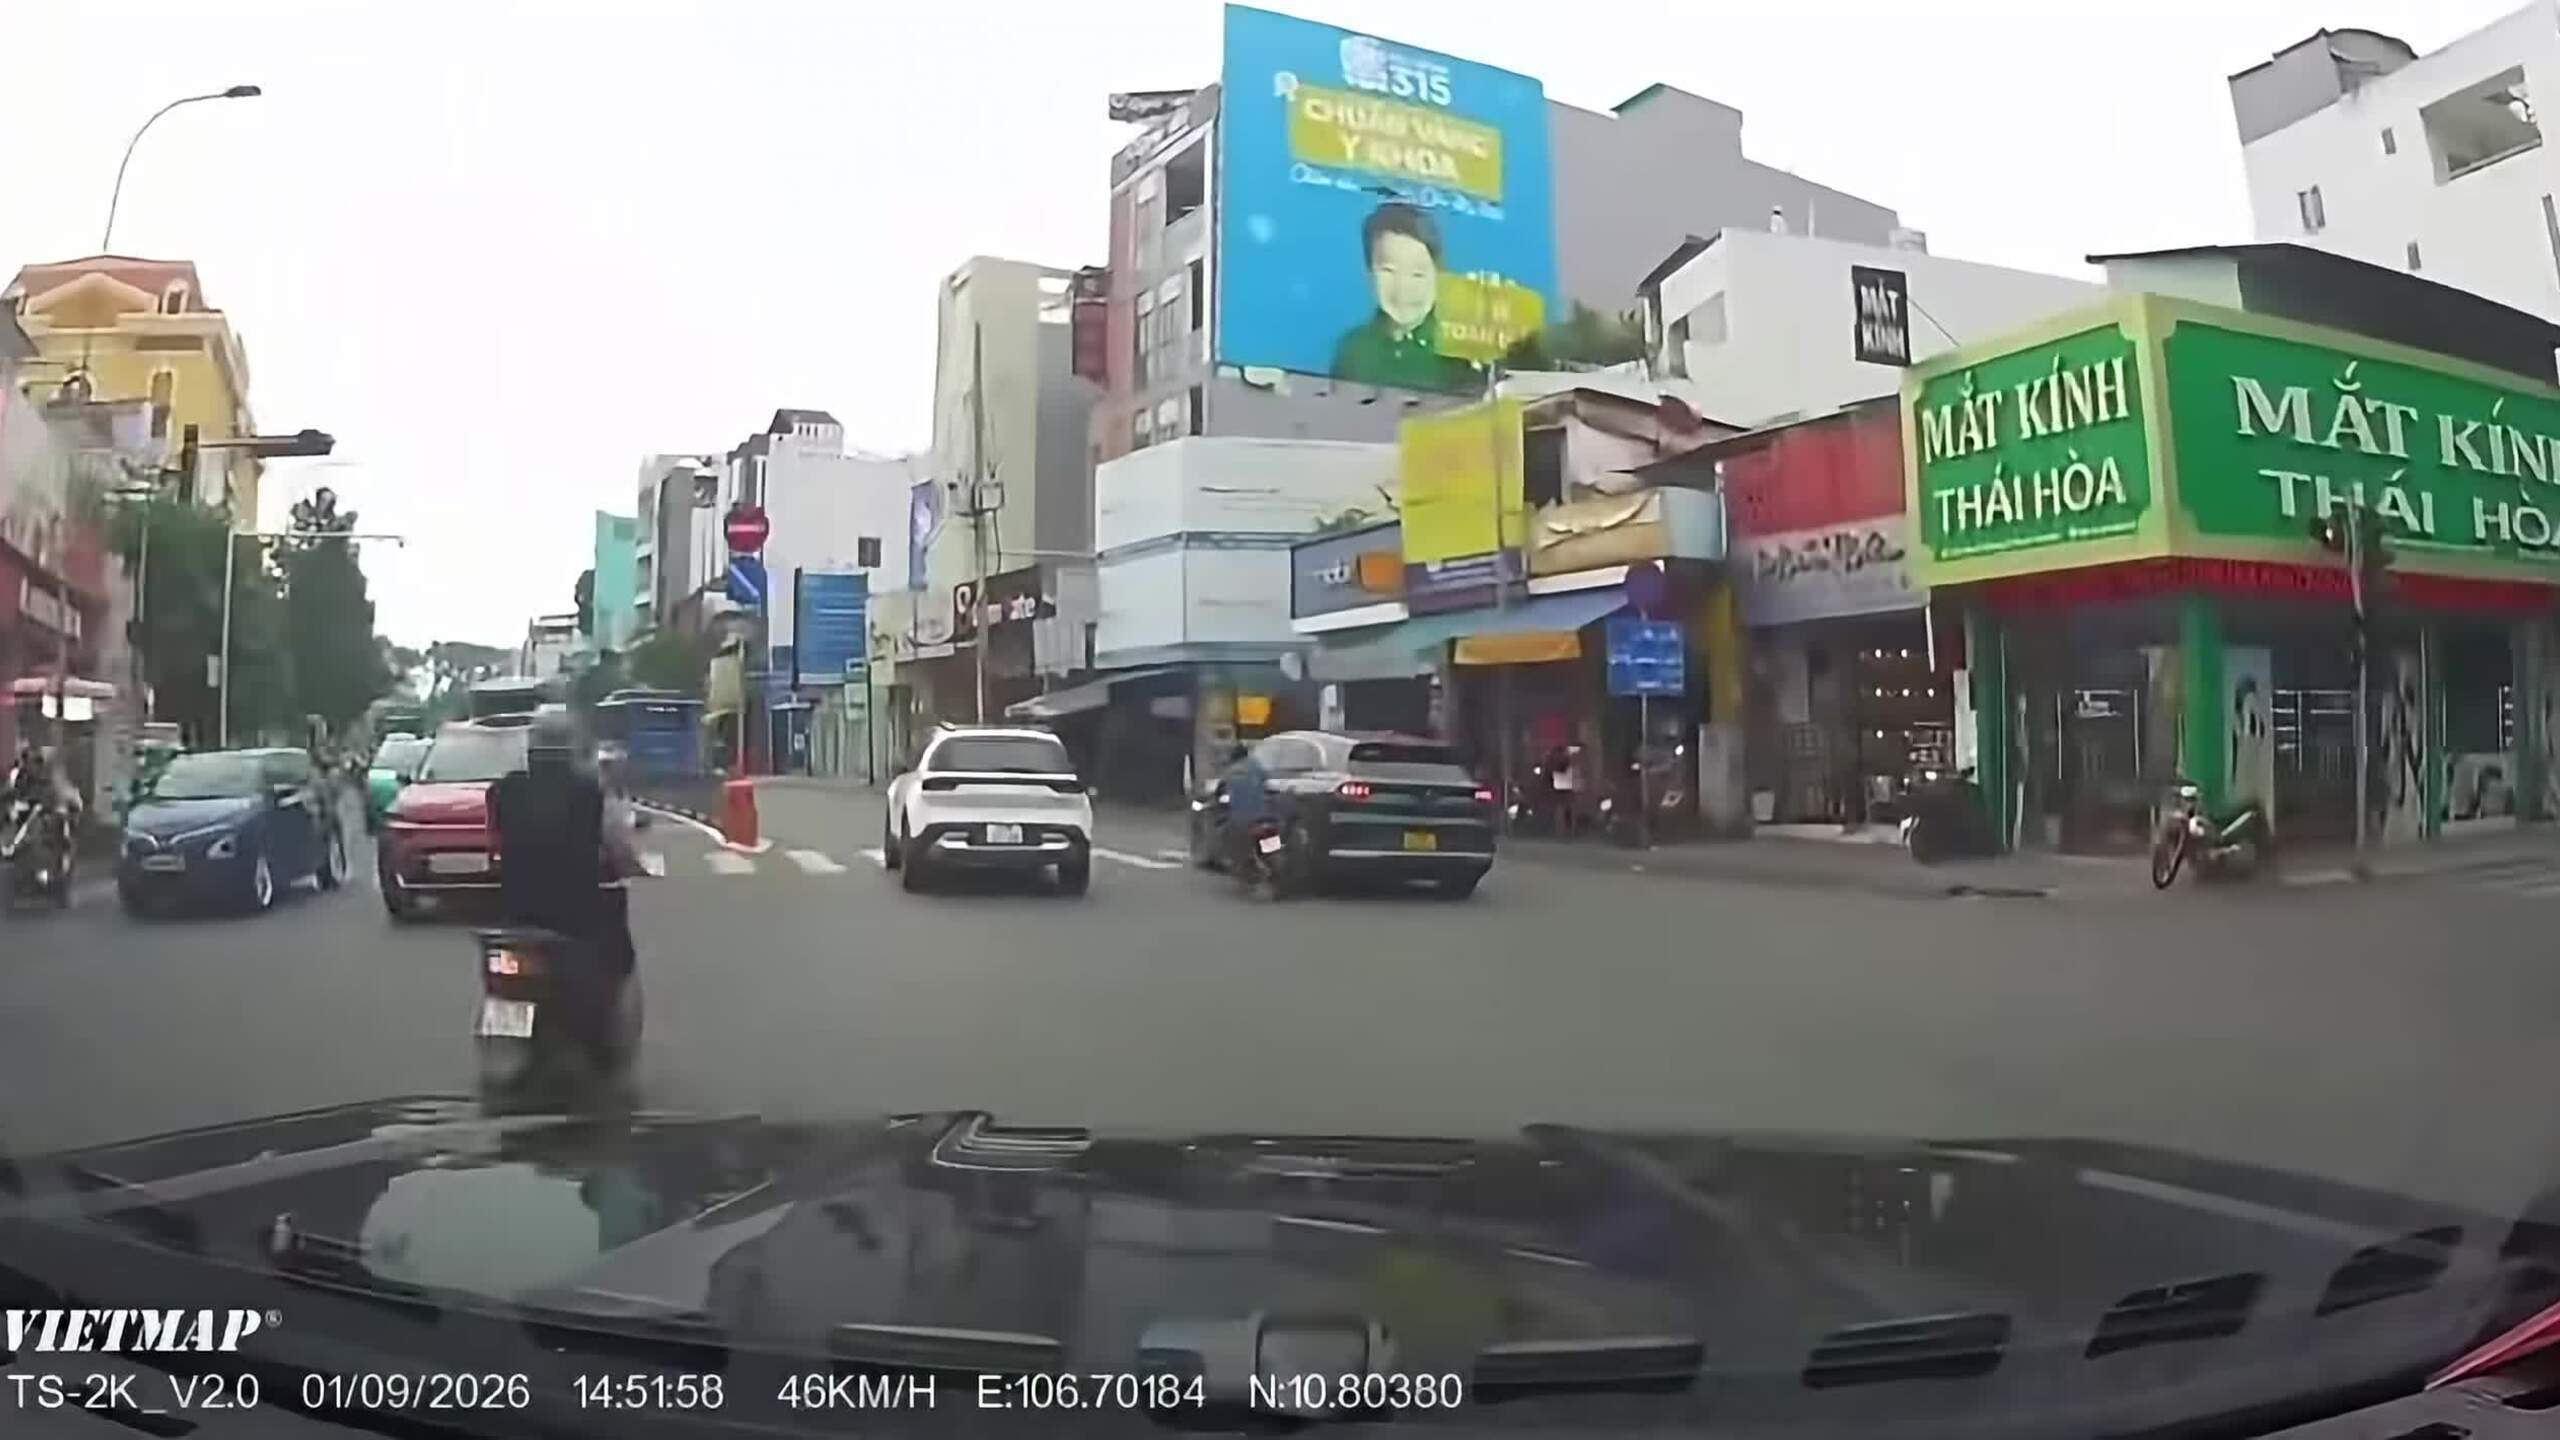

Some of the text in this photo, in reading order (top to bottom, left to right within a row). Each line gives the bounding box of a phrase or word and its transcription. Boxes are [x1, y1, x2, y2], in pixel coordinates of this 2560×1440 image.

[1389, 64, 1452, 107] 315
[1922, 352, 2130, 464] MẮT KÍNH
[2229, 360, 2419, 460] MẮT
[1933, 448, 2128, 535] THÁI HÒA
[2258, 467, 2435, 536] THÁI
